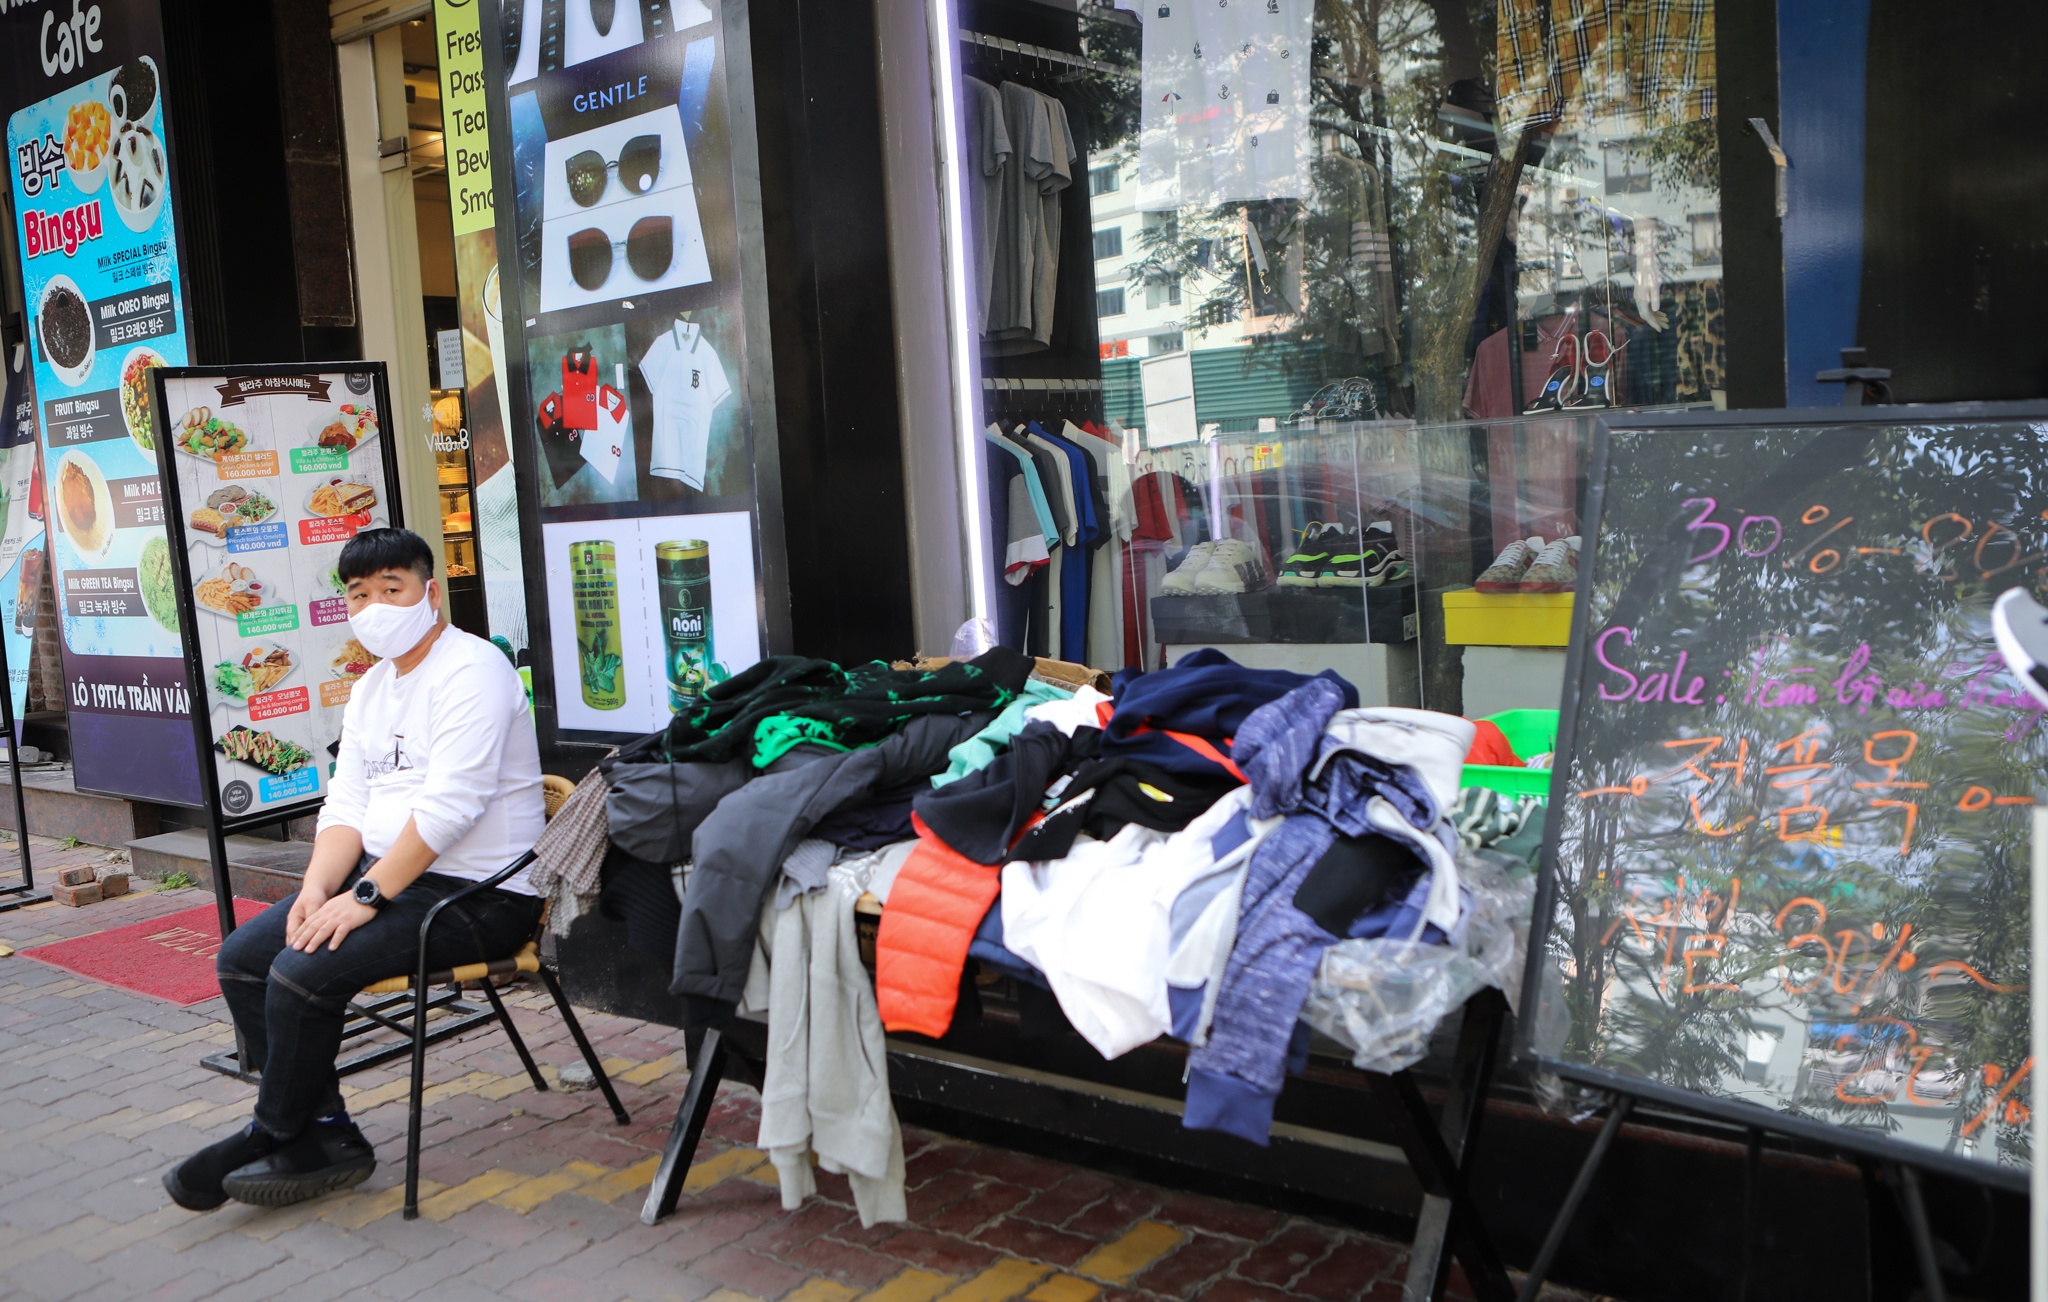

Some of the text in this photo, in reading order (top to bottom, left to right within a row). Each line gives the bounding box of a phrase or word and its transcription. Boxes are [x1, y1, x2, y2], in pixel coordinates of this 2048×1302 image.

[40, 0, 103, 77] Cafe
[446, 30, 482, 59] Fres
[573, 75, 648, 113] GENTLE
[452, 108, 486, 137] Tea
[17, 133, 67, 198] 빙수
[456, 148, 490, 177] Bev
[22, 200, 104, 259] Bingsu
[97, 240, 167, 269] Milk SPECIAL Bingsu
[100, 292, 170, 320] Milk OREO Bingsu
[110, 316, 164, 344] 밀크 오레오 빙수
[264, 376, 312, 389] 아침식사메뉴
[54, 399, 100, 416] FRUIT Bingsu
[80, 422, 94, 439] 빙수
[225, 467, 272, 478] 160.000 vnd
[299, 461, 342, 472] 160.000 vnd
[123, 483, 140, 498] Milk
[141, 482, 155, 496] PAT
[136, 506, 151, 523] 밀크
[235, 539, 282, 551] 140.000 vnd
[307, 531, 350, 543] 140.000 vnd
[67, 576, 134, 592] Milk GREEN TEA Bingsu
[78, 599, 127, 615] 밀크 녹차 빙수
[317, 612, 346, 624] 140.000
[672, 614, 702, 632] noni
[246, 620, 293, 634] 140.000 vnd
[71, 675, 88, 707] LÔ
[90, 683, 126, 710] 19TT4
[126, 673, 163, 713] TRẦN
[330, 694, 350, 704] 90.00
[257, 702, 303, 719] 140.000 vnd
[267, 782, 313, 800] 140.000 vnd
